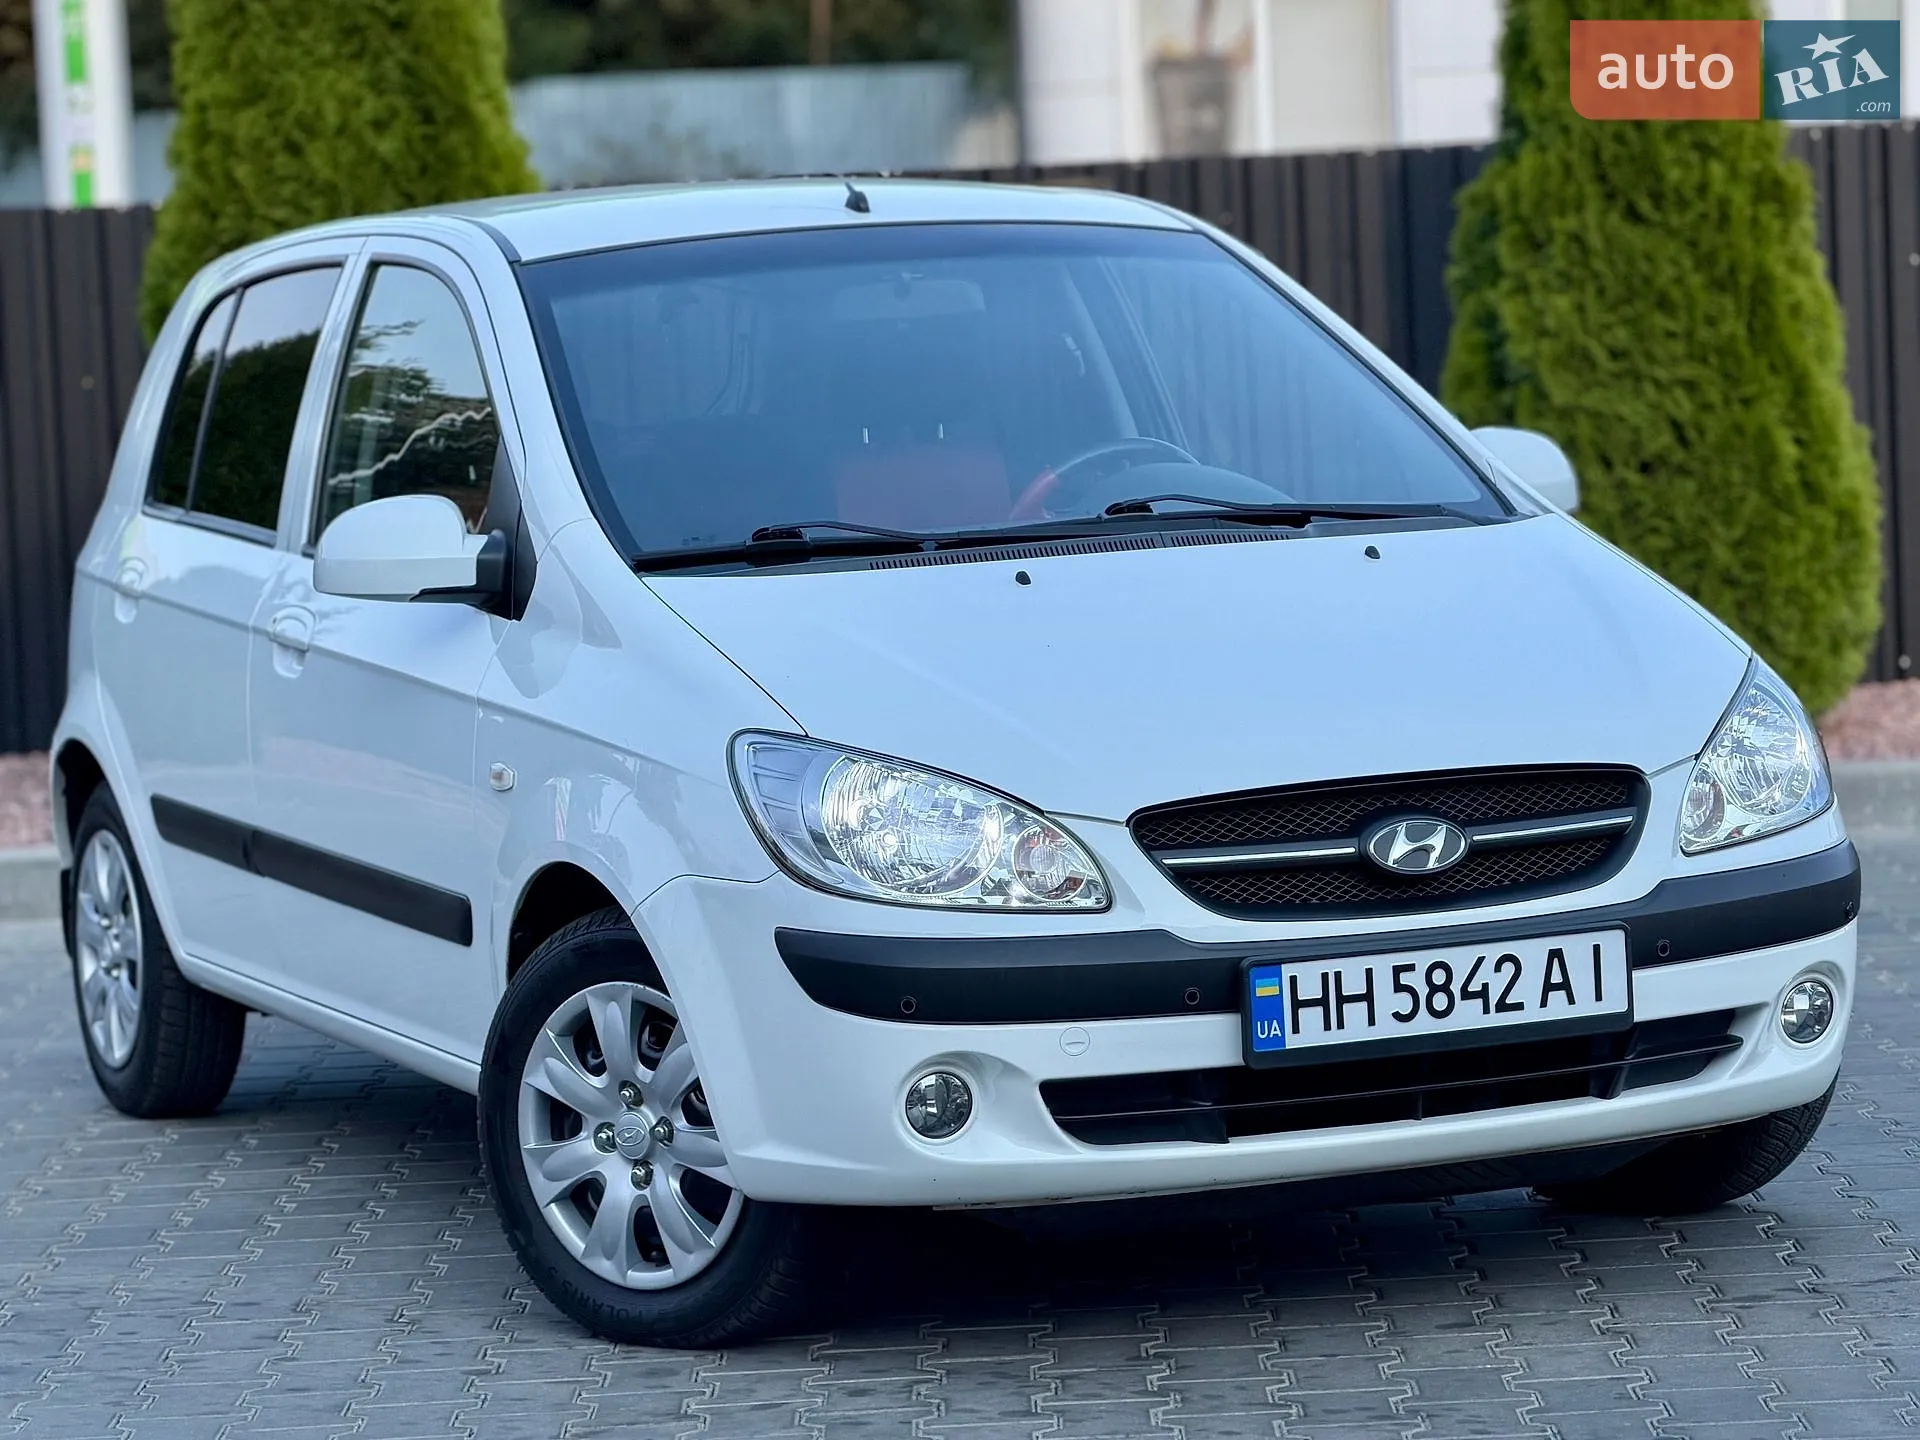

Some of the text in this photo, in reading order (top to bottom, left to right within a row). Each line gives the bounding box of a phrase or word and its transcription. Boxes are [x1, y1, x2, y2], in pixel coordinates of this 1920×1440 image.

[1289, 967, 1376, 1034] HH
[1391, 953, 1525, 1023] 5842
[1257, 1016, 1282, 1039] UA
